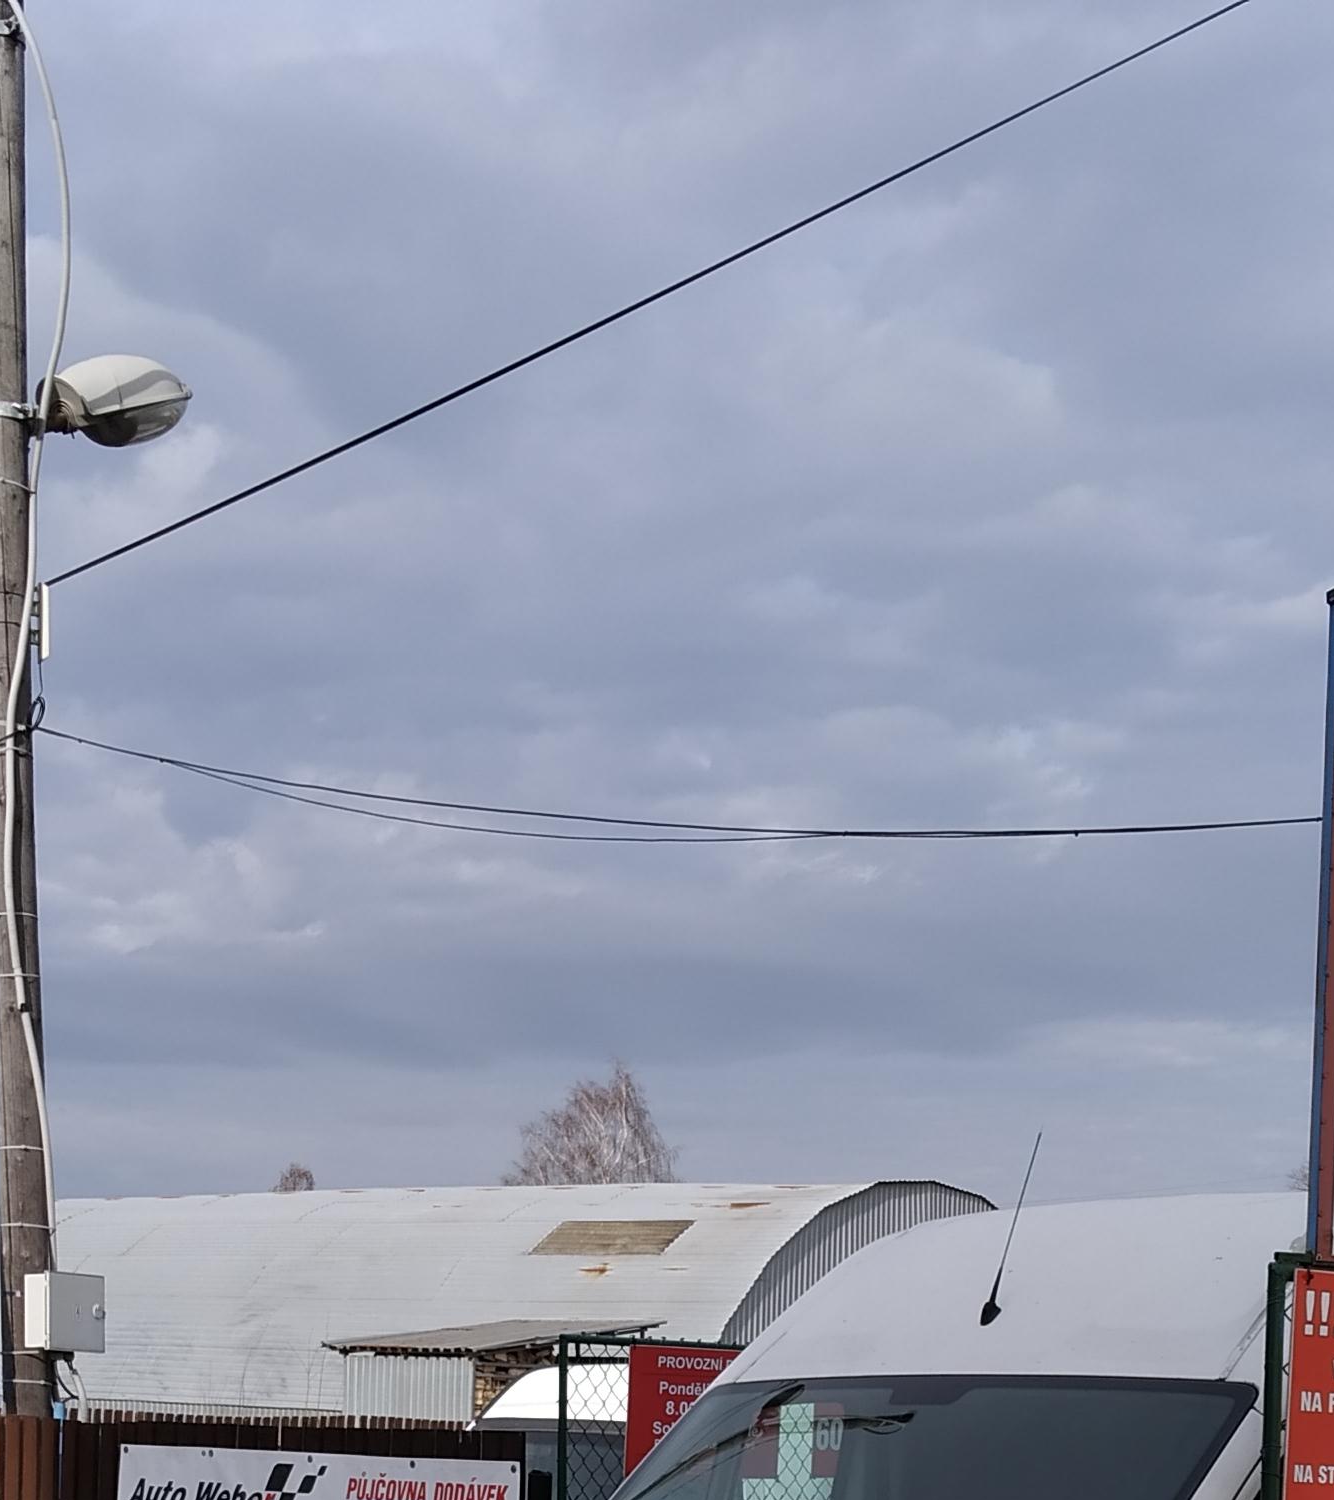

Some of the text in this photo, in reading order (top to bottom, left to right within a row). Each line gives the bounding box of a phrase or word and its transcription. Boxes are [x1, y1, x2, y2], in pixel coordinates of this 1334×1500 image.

[657, 1356, 723, 1371] PROVOZNÍ
[665, 1401, 694, 1416] 8.0
[1300, 1391, 1322, 1413] NA
[1293, 1464, 1314, 1484] NA
